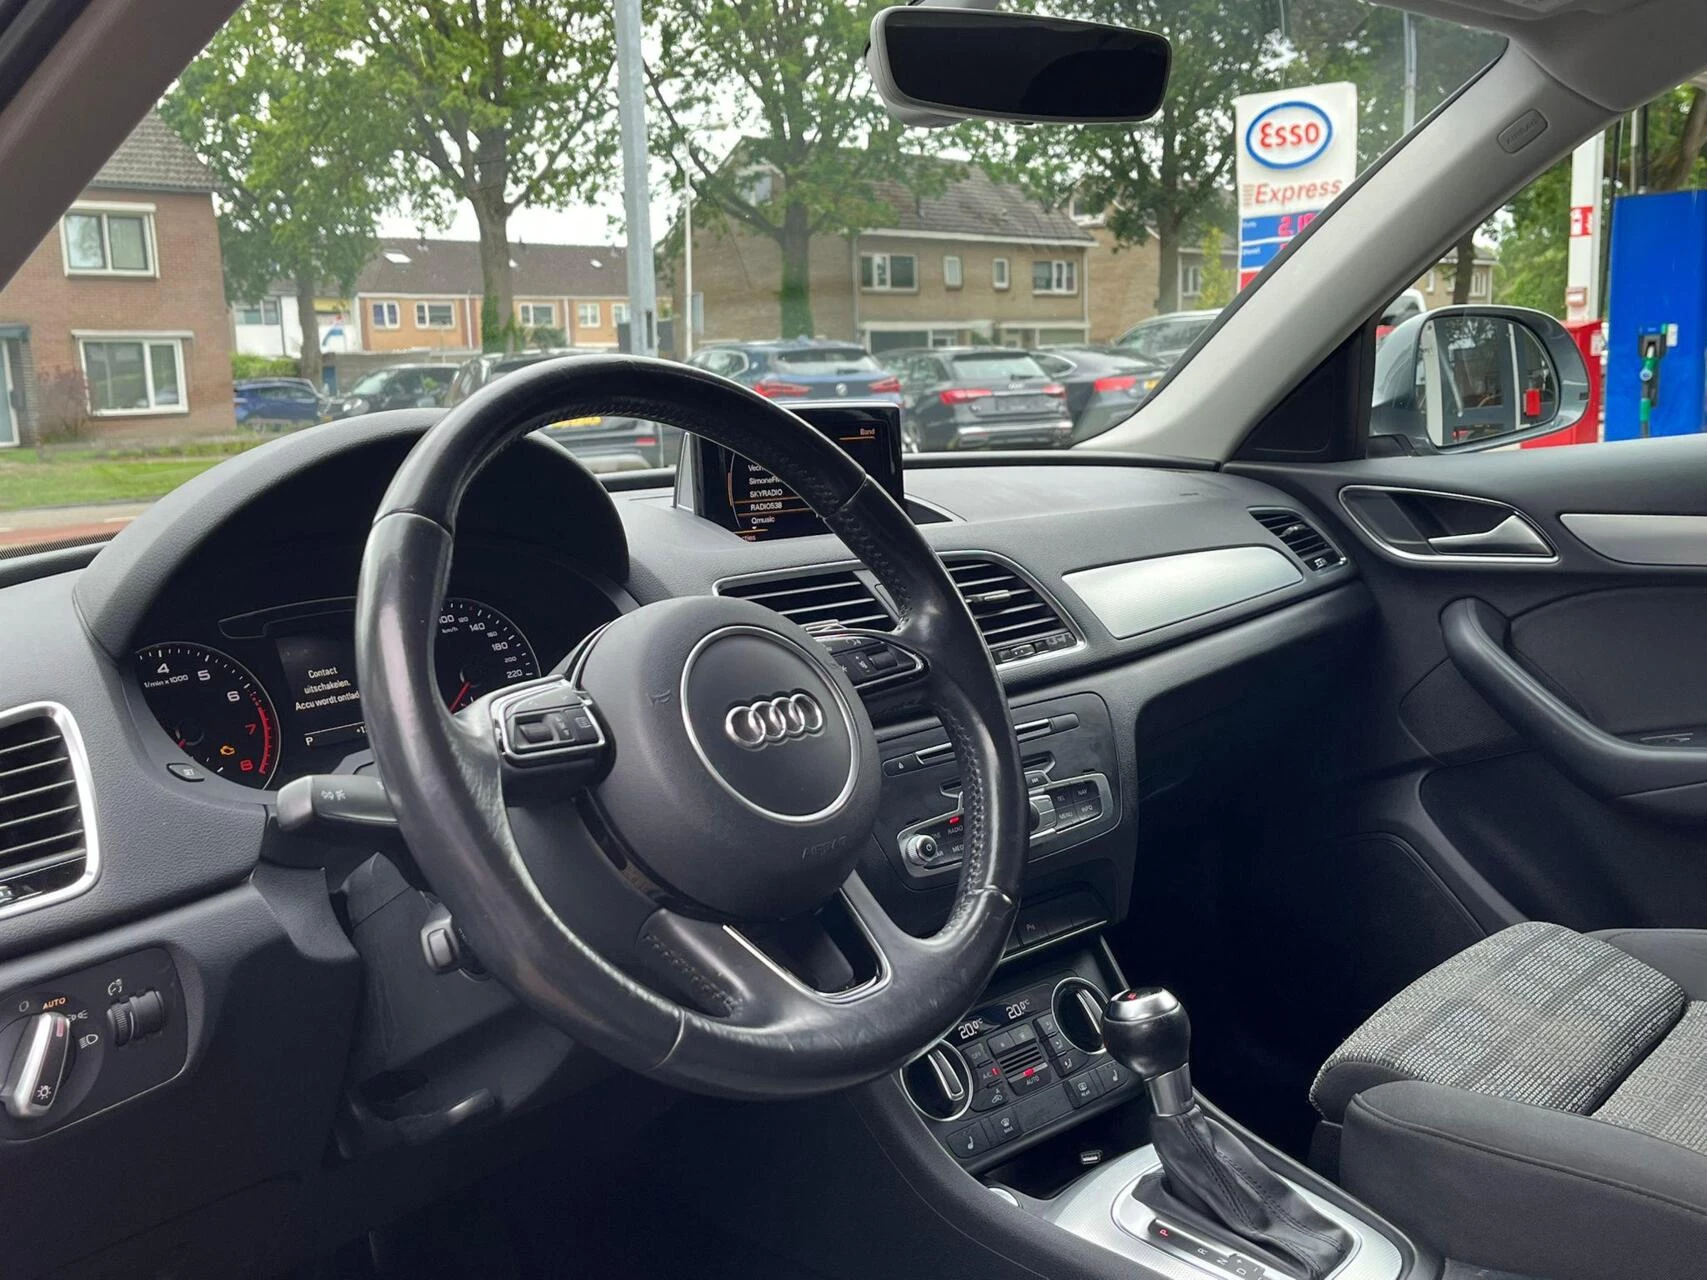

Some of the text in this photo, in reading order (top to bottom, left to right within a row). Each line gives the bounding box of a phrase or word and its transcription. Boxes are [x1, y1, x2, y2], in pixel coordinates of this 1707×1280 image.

[1254, 179, 1343, 206] Express
[750, 489, 783, 498] SKYRADIO
[750, 502, 783, 511] RADIO538
[751, 517, 775, 525] Qmusic
[469, 622, 486, 632] 140
[491, 641, 508, 651] 180
[157, 663, 170, 673] 4
[308, 667, 338, 678] Contact
[169, 674, 189, 683] 1000
[197, 669, 211, 681] 5
[506, 669, 523, 679] 220
[227, 690, 240, 702] 6
[295, 701, 315, 711] Accu
[315, 695, 338, 707] wordt
[245, 723, 257, 735] 7
[305, 736, 314, 746] P
[240, 759, 253, 771] 8
[42, 997, 67, 1011] AUTO
[1160, 1229, 1169, 1237] P
